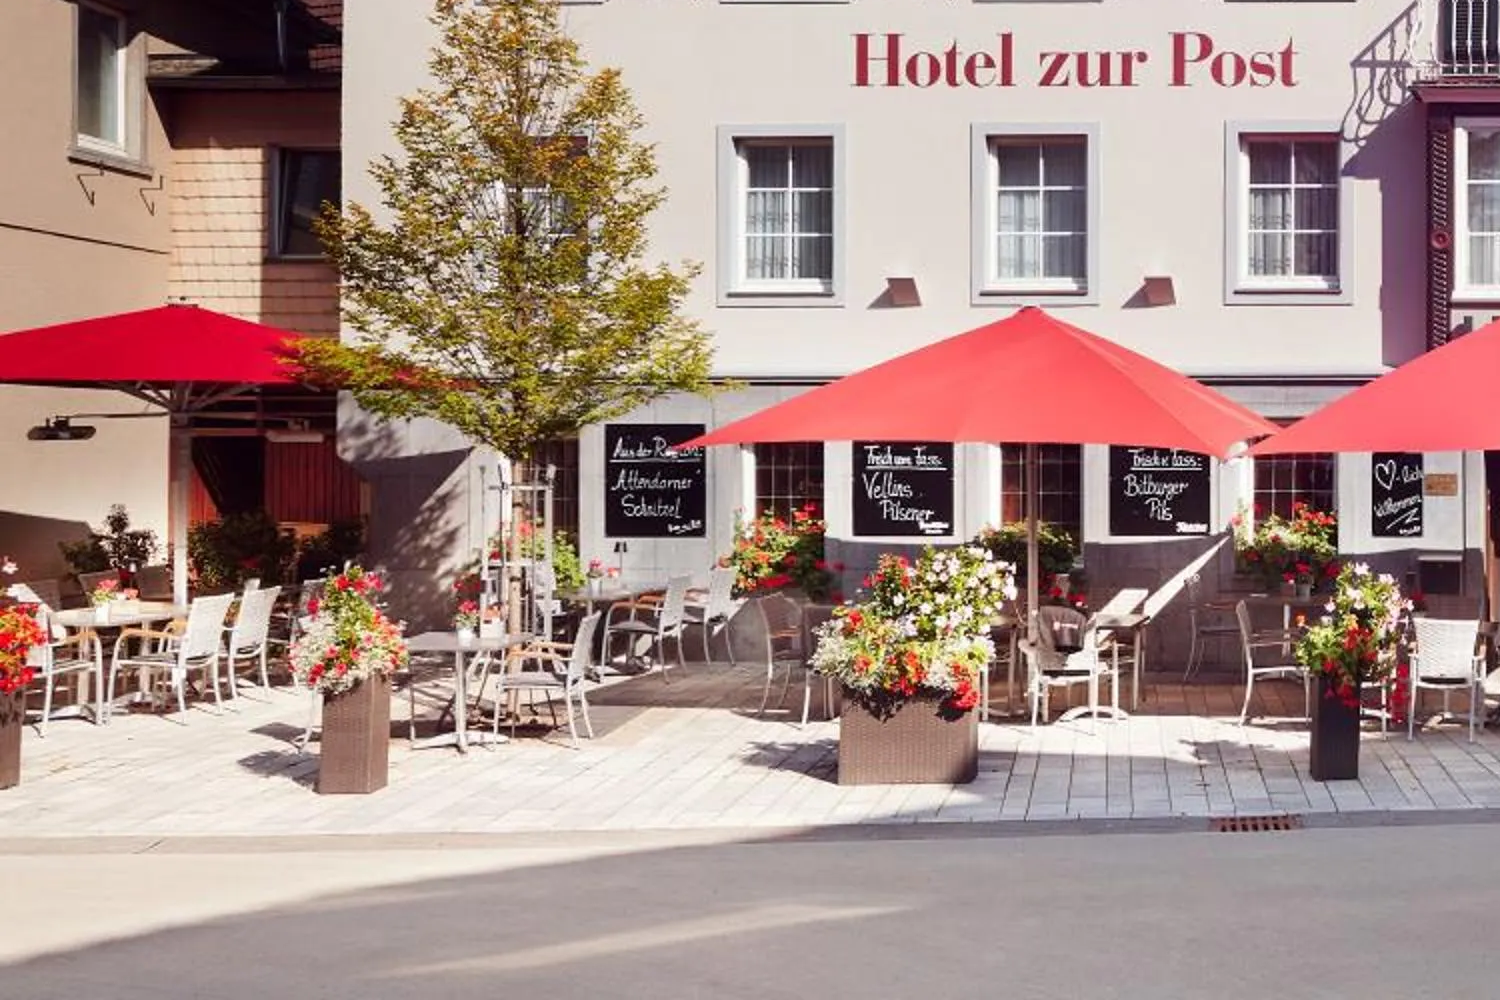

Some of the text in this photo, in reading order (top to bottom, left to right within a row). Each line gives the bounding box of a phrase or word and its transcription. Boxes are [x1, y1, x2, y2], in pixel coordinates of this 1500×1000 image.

[849, 31, 1298, 88] Hotel zur Post
[613, 436, 635, 458] Aus
[636, 441, 652, 457] der
[861, 471, 913, 499] Veltins
[1123, 473, 1189, 501] Bitburger
[621, 493, 683, 519] Schnitzel
[879, 499, 935, 521] Pilsener
[1144, 497, 1173, 521] Pils
